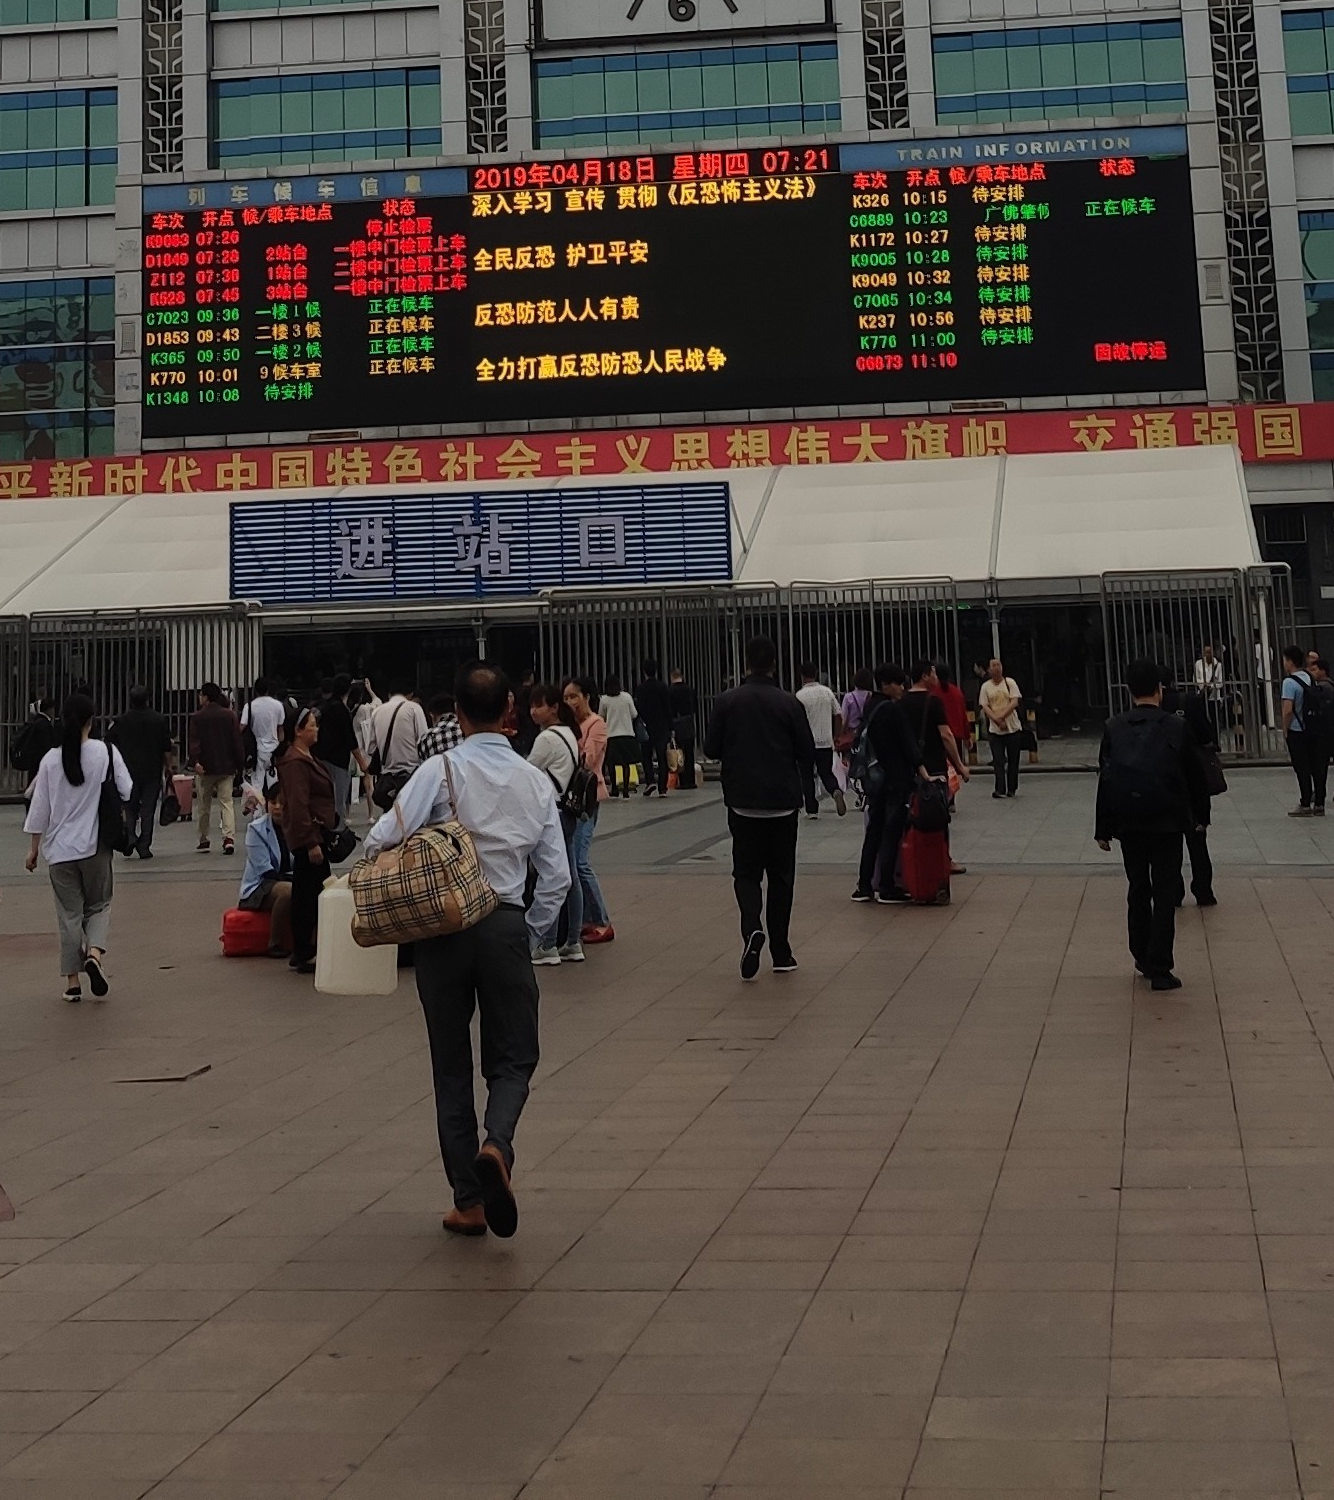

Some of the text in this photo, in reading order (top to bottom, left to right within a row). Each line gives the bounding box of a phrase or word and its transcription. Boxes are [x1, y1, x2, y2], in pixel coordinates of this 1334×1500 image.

[897, 136, 1131, 163] TRAIN INFORMATION
[474, 149, 830, 190] 2019年04月18日 星期四 07:21
[853, 171, 888, 190] 车次
[906, 168, 941, 187] 开点
[1099, 158, 1135, 176] 状态
[188, 174, 421, 207] 列车候车信息
[472, 176, 818, 217] 深入学习 宣传 贯彻 《反恐怖主义法》
[853, 184, 1025, 208] K326 10:15 待安排
[151, 212, 185, 230] 车次
[202, 209, 235, 227] 开点
[903, 210, 948, 225] 10:23
[1085, 196, 1156, 216] 正在候车
[850, 223, 1027, 248] K1172 10:27 待安排
[473, 240, 649, 272] 全民反恐 护卫平安
[851, 243, 1029, 268] K9005 10:28 待安排
[906, 269, 951, 285] 10:32
[976, 263, 1030, 284] 待安排
[368, 295, 434, 314] 正在候车
[908, 291, 952, 306] 10:34
[978, 284, 1031, 304] 待安排
[474, 295, 640, 326] 反恐防范人人有责
[858, 305, 1033, 329] K237 10:56 待安排
[146, 331, 189, 346] D1853
[196, 328, 240, 343] 09:43
[368, 315, 435, 335] 正在候车
[911, 332, 956, 348] 11:00
[981, 326, 1034, 346] 待安排
[151, 351, 185, 366] K365
[197, 348, 240, 362] 09:50
[368, 335, 435, 354] 正在候车
[475, 346, 727, 382] 全力打赢反恐防恐人民战争
[150, 371, 186, 386] K770
[198, 368, 238, 383] 10:01
[369, 356, 435, 375] 正在候车
[146, 382, 314, 406] K1348 10:08 待安排
[1068, 407, 1303, 457] 交通强国
[335, 514, 627, 581] 进站口
